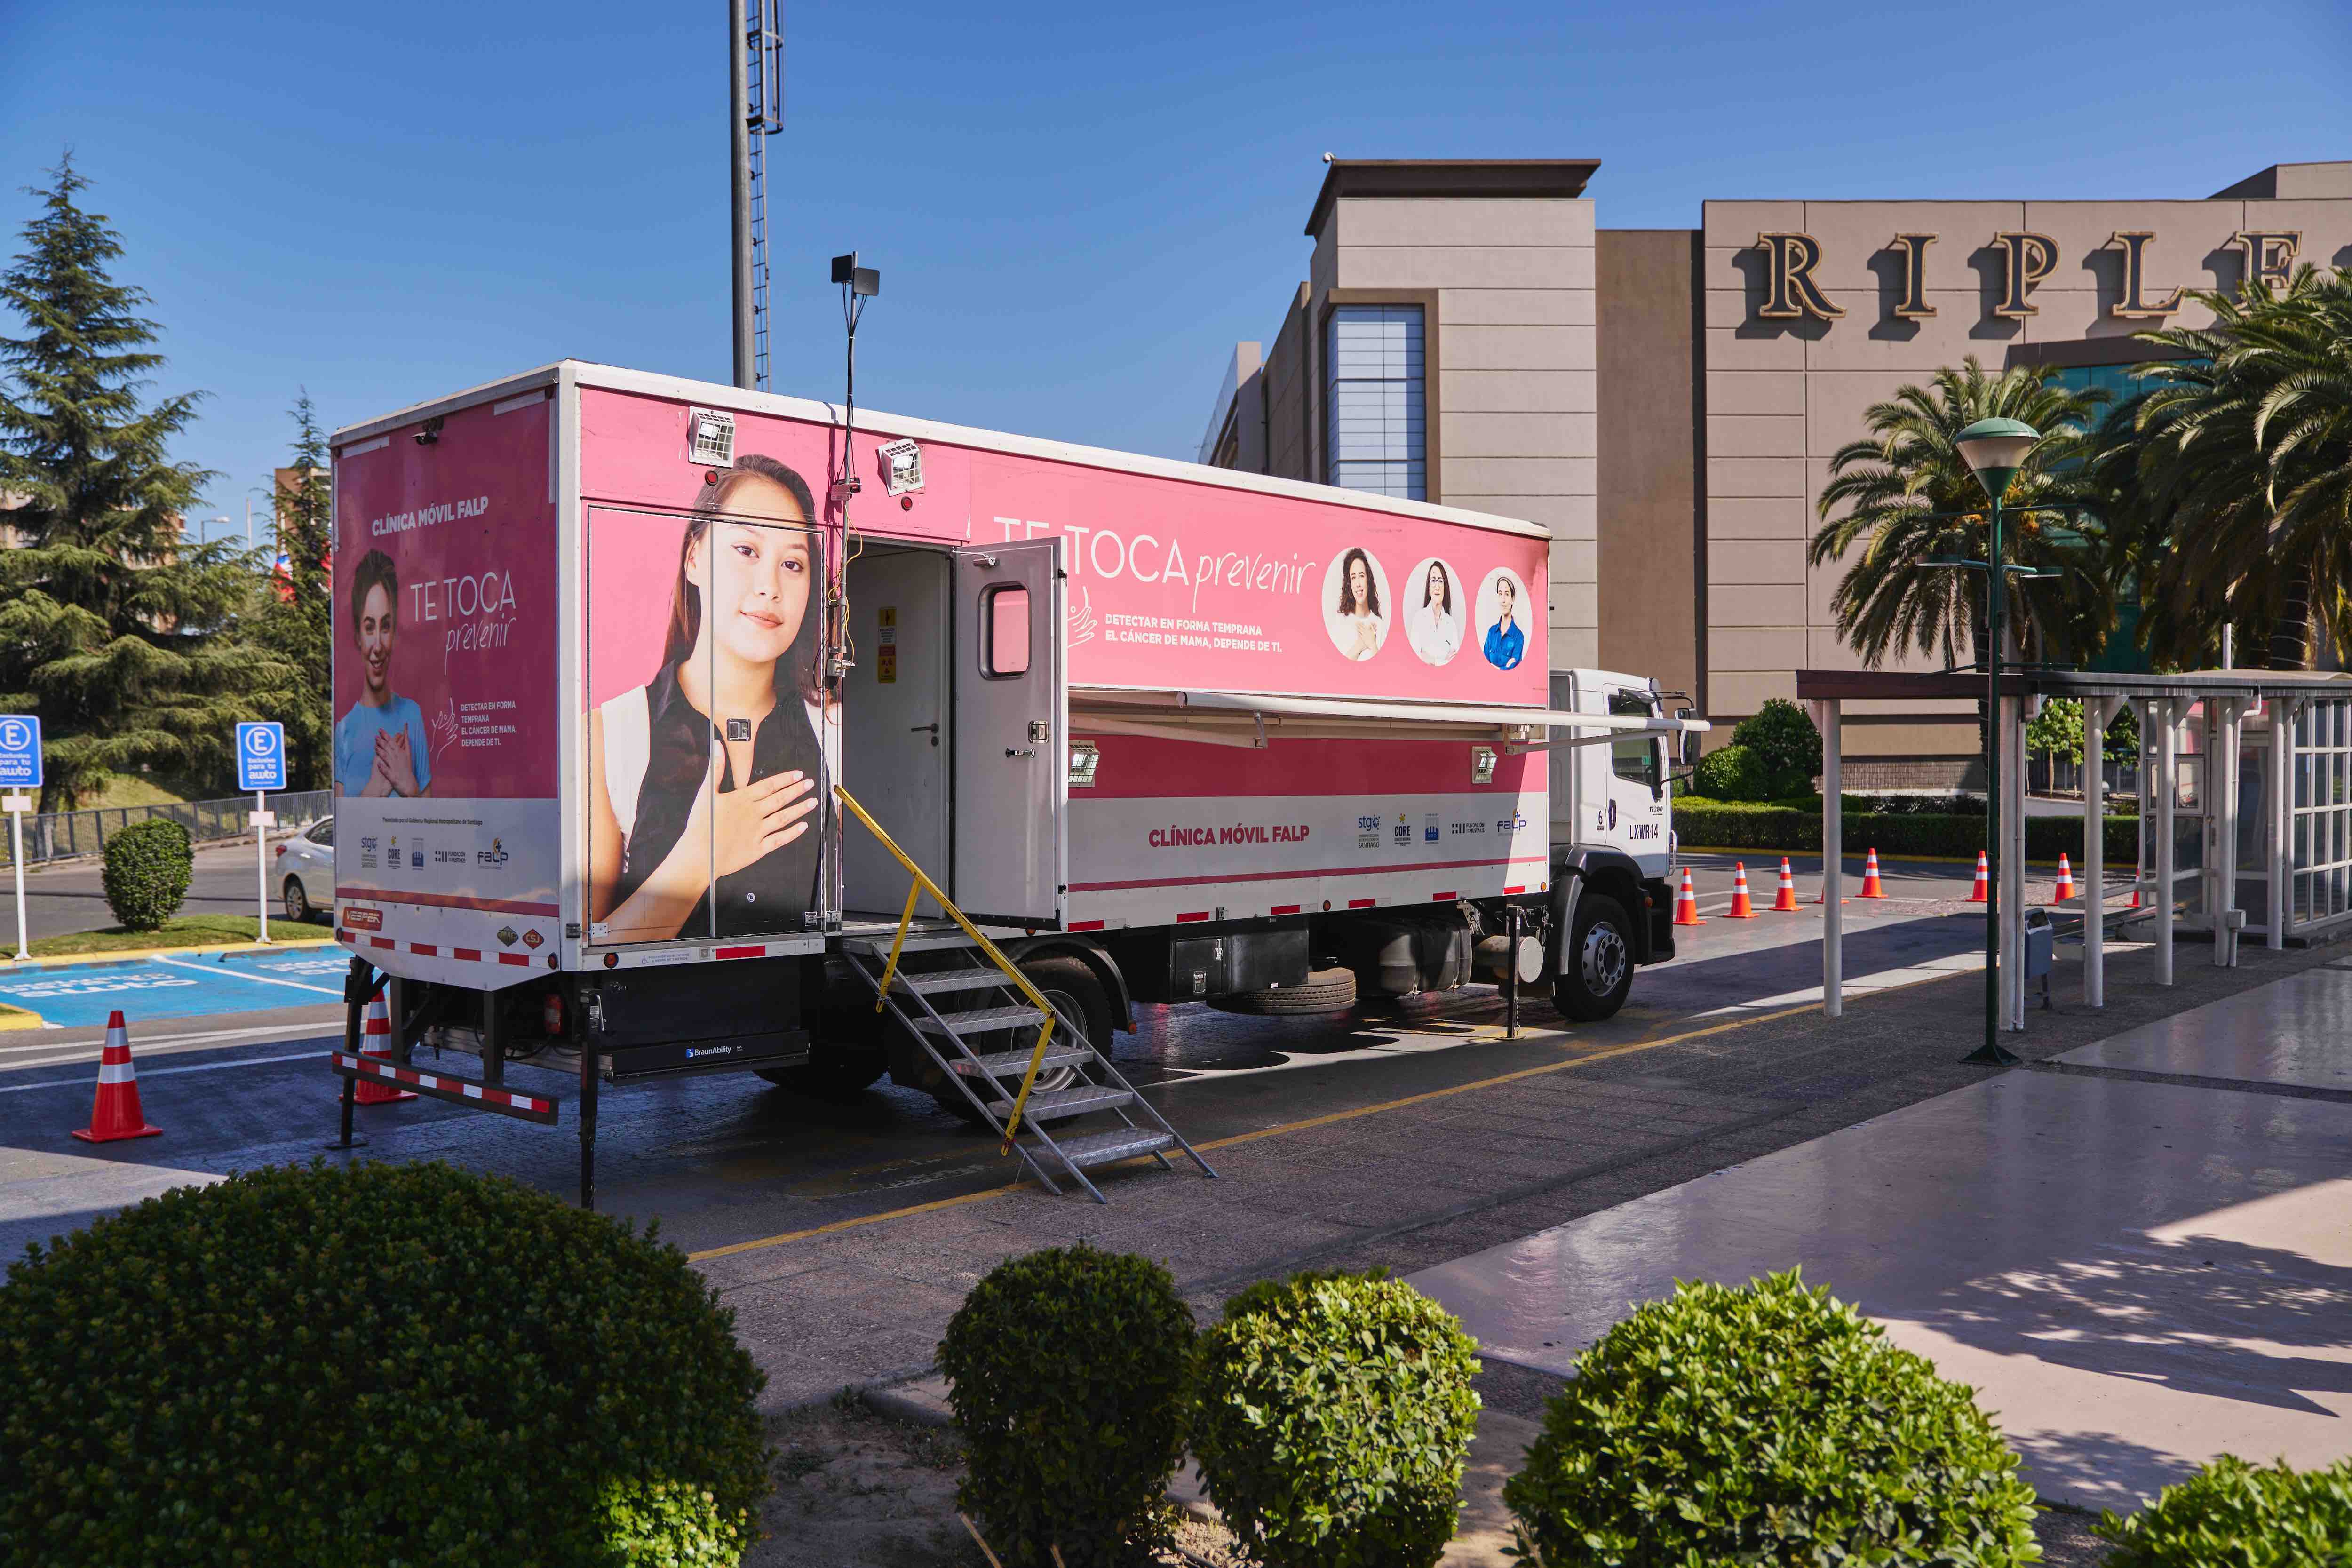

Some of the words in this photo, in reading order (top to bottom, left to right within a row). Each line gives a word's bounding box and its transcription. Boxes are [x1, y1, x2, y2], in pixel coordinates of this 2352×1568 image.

[372, 512, 416, 536] CLÍNICA
[418, 503, 455, 527] MÓVIL
[457, 496, 489, 519] FALP
[1064, 525, 1189, 586] TOCA
[1193, 552, 1317, 614] prevenir
[410, 581, 437, 622] TE
[443, 568, 516, 618] TOCA
[1105, 613, 1158, 628] DETECTAR
[1160, 617, 1174, 629] EN
[1176, 619, 1210, 632] FORMA
[1212, 622, 1263, 636] TEMPRANA
[444, 613, 516, 676] prevenir
[1105, 630, 1118, 641] EL
[1120, 629, 1162, 645] CÁNCER
[1164, 634, 1178, 645] DE
[1180, 636, 1212, 650] MAMA,
[1214, 637, 1255, 651] DEPENDE
[1257, 640, 1270, 651] DE
[1271, 642, 1282, 653] TI.
[461, 703, 488, 712] DETECTAR
[497, 700, 516, 709] FORMA
[461, 714, 490, 723] TEMPRANA
[5, 724, 22, 746] E
[469, 724, 490, 735] CÁNCER
[499, 725, 517, 734] MAMA,
[254, 731, 268, 751] E
[461, 738, 485, 747] DEPENDE
[1598, 810, 1603, 824] 6
[1148, 824, 1216, 847] CLÍNICA
[1219, 822, 1269, 844] MÓVIL
[1272, 825, 1310, 842] FALP
[1394, 825, 1411, 836] CORE
[388, 848, 400, 860] CORE
[694, 1046, 731, 1056] BraunAbility
